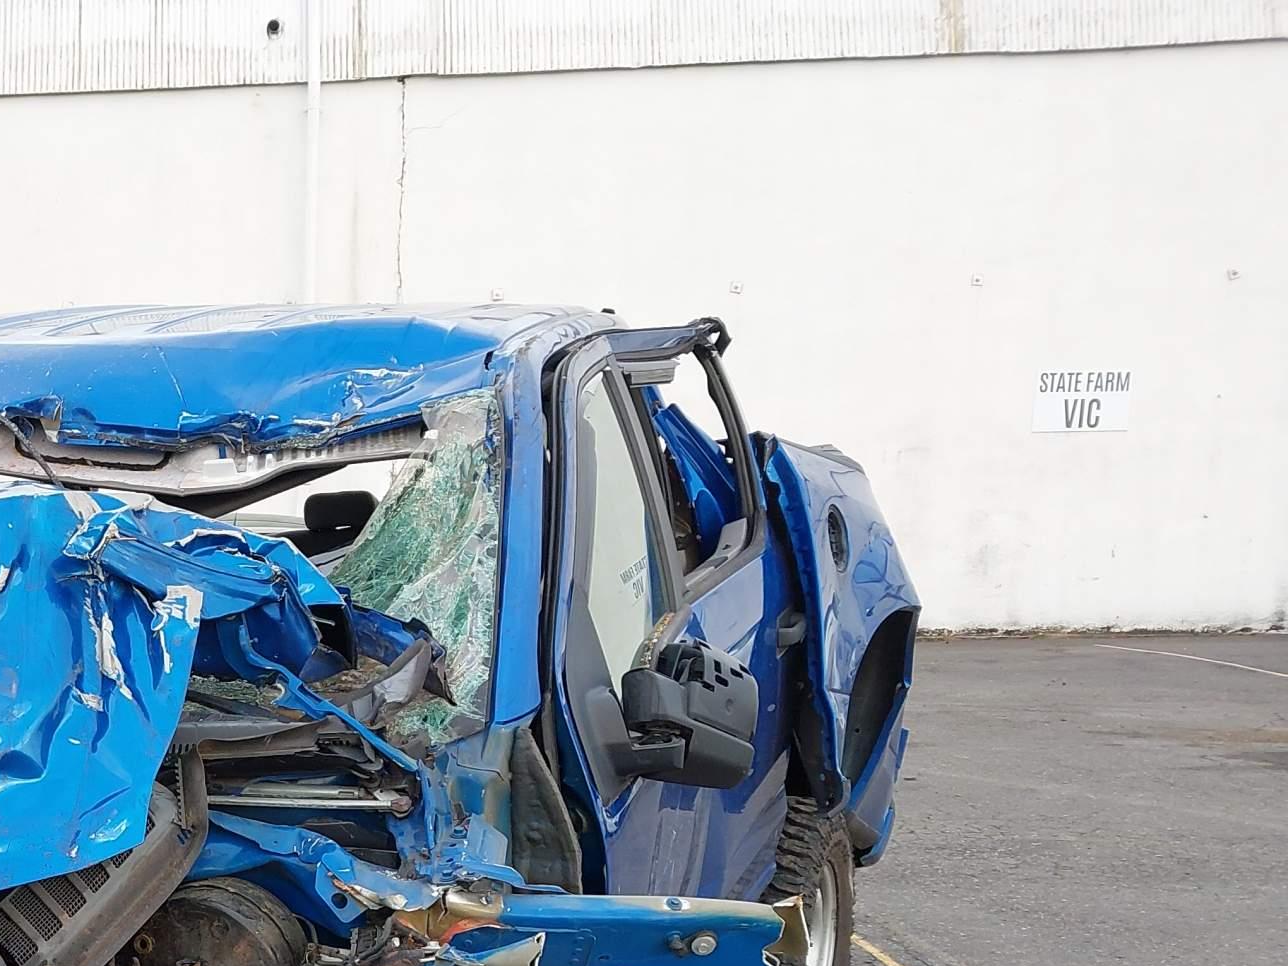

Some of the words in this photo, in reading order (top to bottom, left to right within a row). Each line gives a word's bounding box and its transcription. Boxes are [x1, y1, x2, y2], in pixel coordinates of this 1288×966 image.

[1039, 371, 1083, 393] STATE
[1086, 371, 1131, 393] FARM
[1064, 397, 1101, 429] VIC
